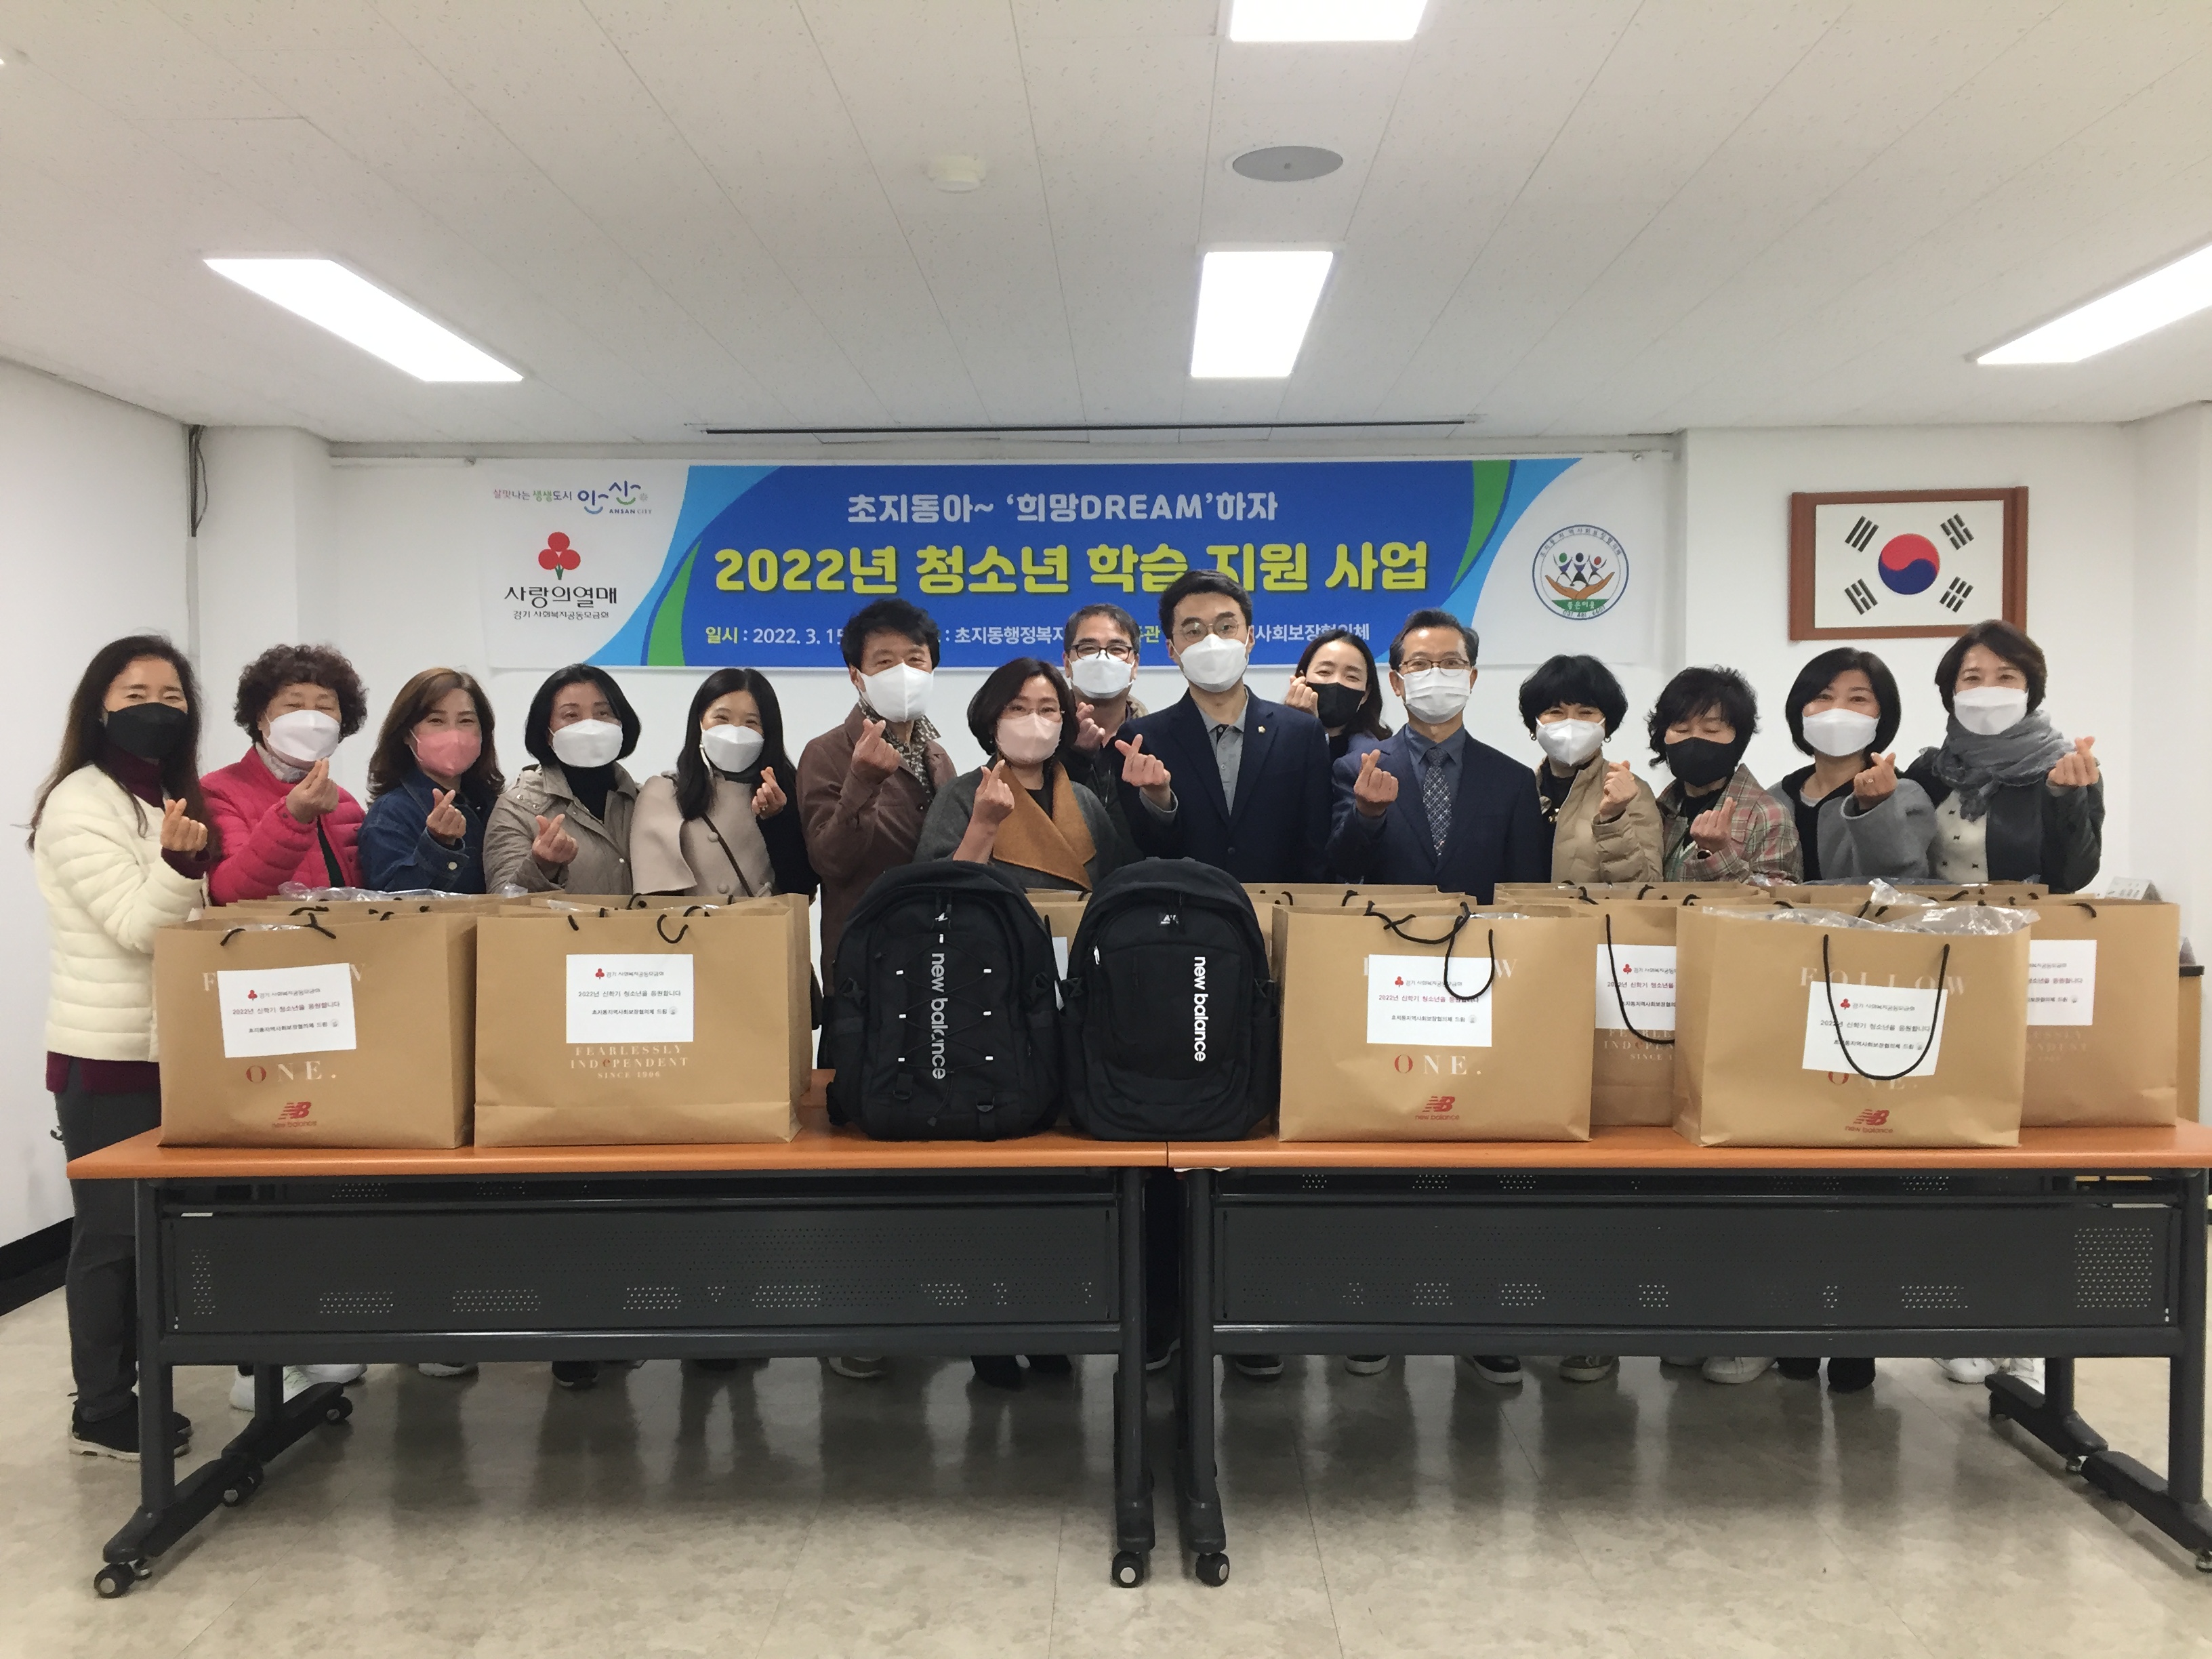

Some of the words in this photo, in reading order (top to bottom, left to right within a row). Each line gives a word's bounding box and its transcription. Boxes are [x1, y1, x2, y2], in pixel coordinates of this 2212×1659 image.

[493, 489, 531, 501] 살맛나는
[533, 489, 572, 502] 생생도시
[848, 493, 994, 523] 초지동아~
[714, 545, 899, 594] 2022년
[916, 544, 1069, 594] 청소년
[1086, 543, 1189, 592] 학습
[1205, 542, 1309, 592] 지원
[1324, 541, 1428, 591] 사업
[504, 586, 617, 608] 사랑의열매
[513, 611, 531, 620] 경기
[533, 611, 609, 620] 사회복지공동모금회
[705, 626, 738, 644] 일시
[753, 628, 801, 644] 2022.
[806, 628, 821, 644] 3.
[931, 953, 945, 993] new
[1194, 956, 1206, 992] new
[1194, 994, 1209, 1062] balance
[575, 1044, 683, 1056] FEARLESSLY
[1394, 1054, 1482, 1075] ONE.
